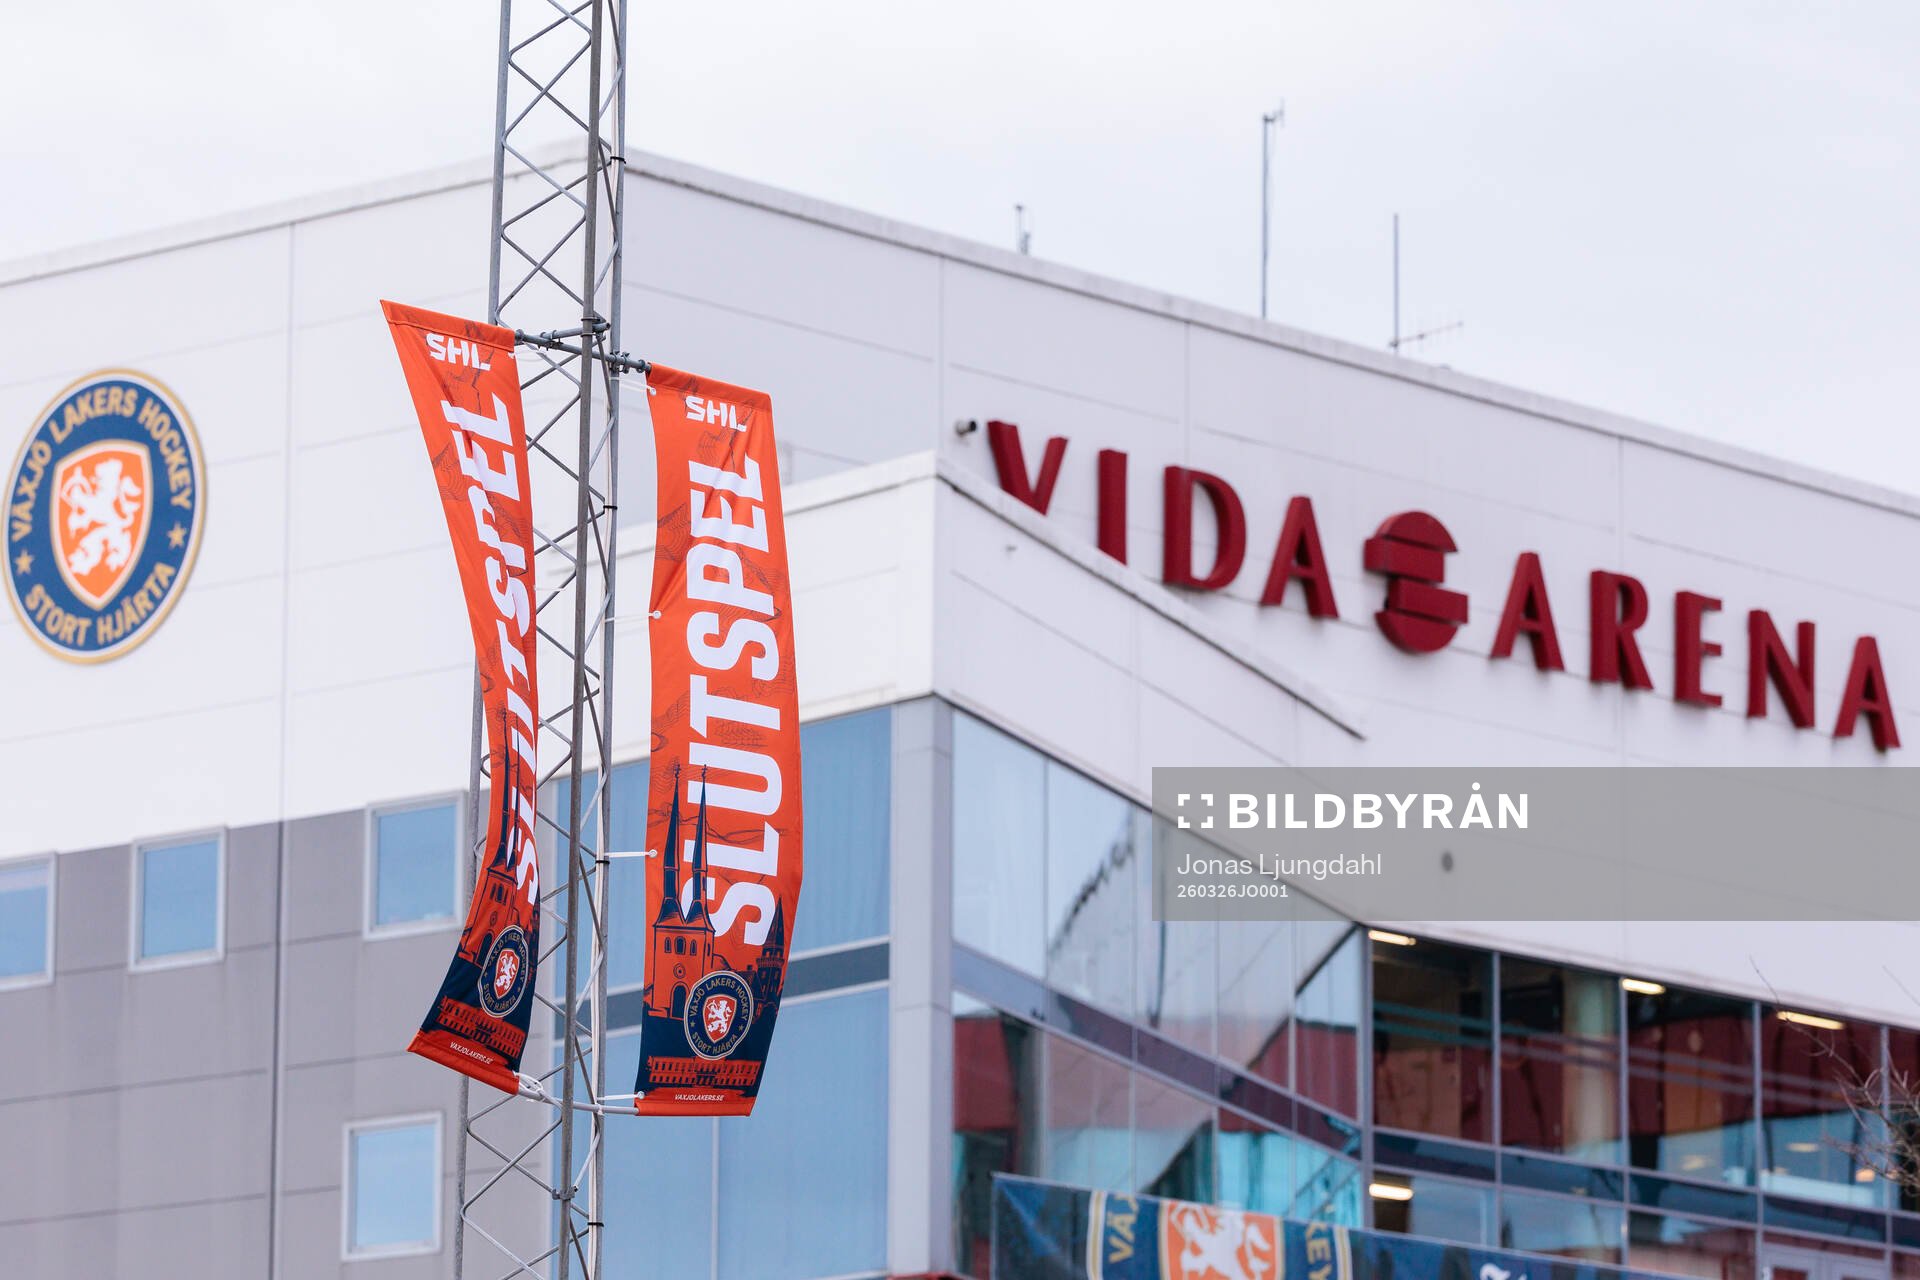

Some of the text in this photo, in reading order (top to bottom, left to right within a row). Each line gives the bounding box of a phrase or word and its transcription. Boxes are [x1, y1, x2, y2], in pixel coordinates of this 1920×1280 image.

[426, 332, 491, 371] SHL
[685, 395, 747, 432] SHL
[49, 386, 139, 444] LAKERS
[138, 397, 192, 510] HOCKEY
[25, 561, 175, 647] STORT HJÄRTA
[987, 419, 1902, 753] VIDA ARENA
[681, 450, 783, 946] SLUTSPEL
[705, 978, 736, 991] LAKERS
[735, 985, 749, 1021] HOCKEY
[692, 1031, 712, 1052] STORT
